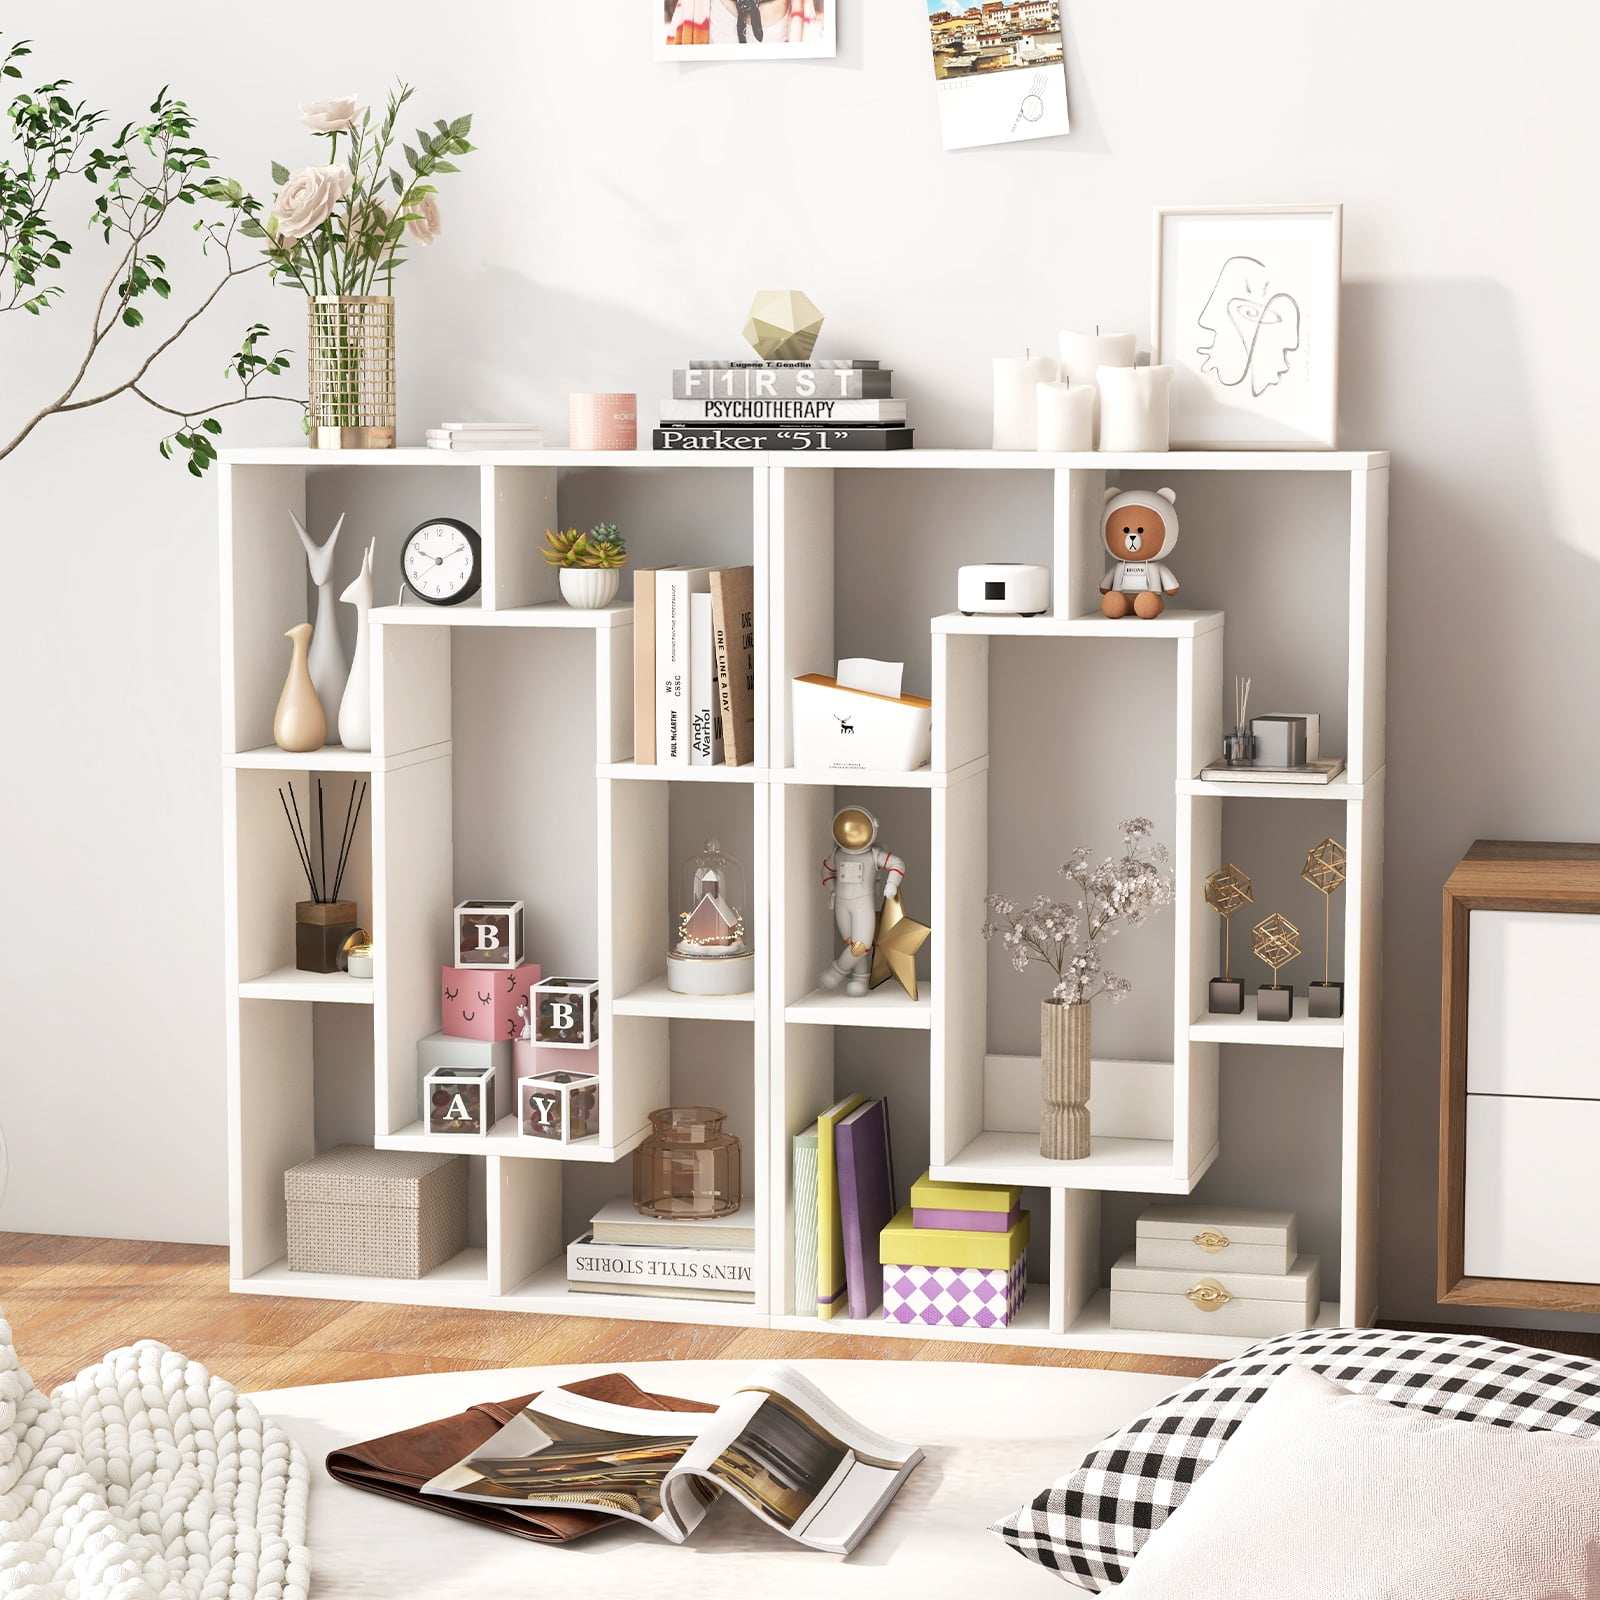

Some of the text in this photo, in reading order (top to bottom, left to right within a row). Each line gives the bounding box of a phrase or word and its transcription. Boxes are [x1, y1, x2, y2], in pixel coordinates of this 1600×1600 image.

[730, 361, 763, 369] Eugene
[705, 400, 835, 418] PSYCHOTHERAPY
[661, 431, 767, 449] Parker
[666, 680, 672, 693] WS
[722, 692, 730, 712] DAY
[693, 714, 704, 751] Andy
[702, 709, 710, 757] Warhol
[474, 924, 500, 950] B
[550, 1003, 574, 1029] B
[443, 1093, 472, 1121] A
[533, 1096, 555, 1125] Y
[576, 1256, 752, 1281] MEN'S STYLE STORIES
